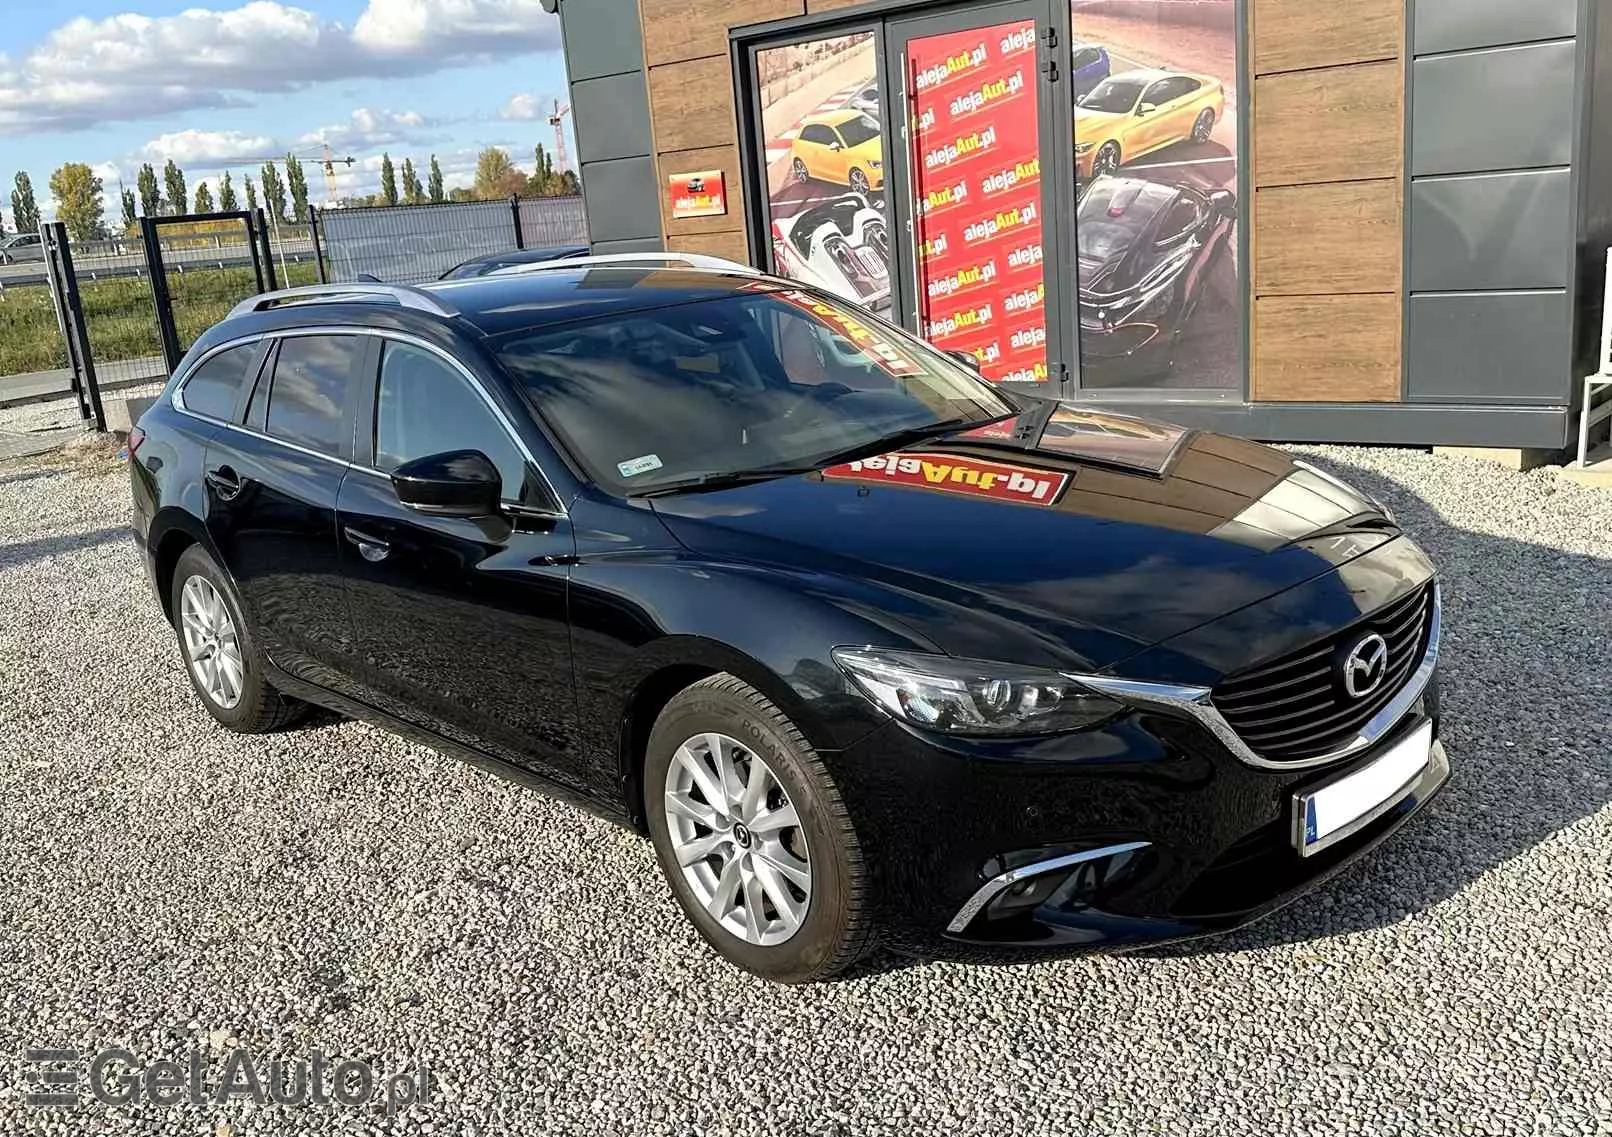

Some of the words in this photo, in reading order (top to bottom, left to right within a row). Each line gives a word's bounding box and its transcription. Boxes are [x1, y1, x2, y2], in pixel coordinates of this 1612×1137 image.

[950, 70, 1024, 116] alejaAut.pl
[925, 126, 996, 169] alejaAut.pl
[963, 202, 1036, 242] alejaAut.pl
[928, 260, 996, 297] alejaAut.pl
[742, 718, 798, 781] POLARIS
